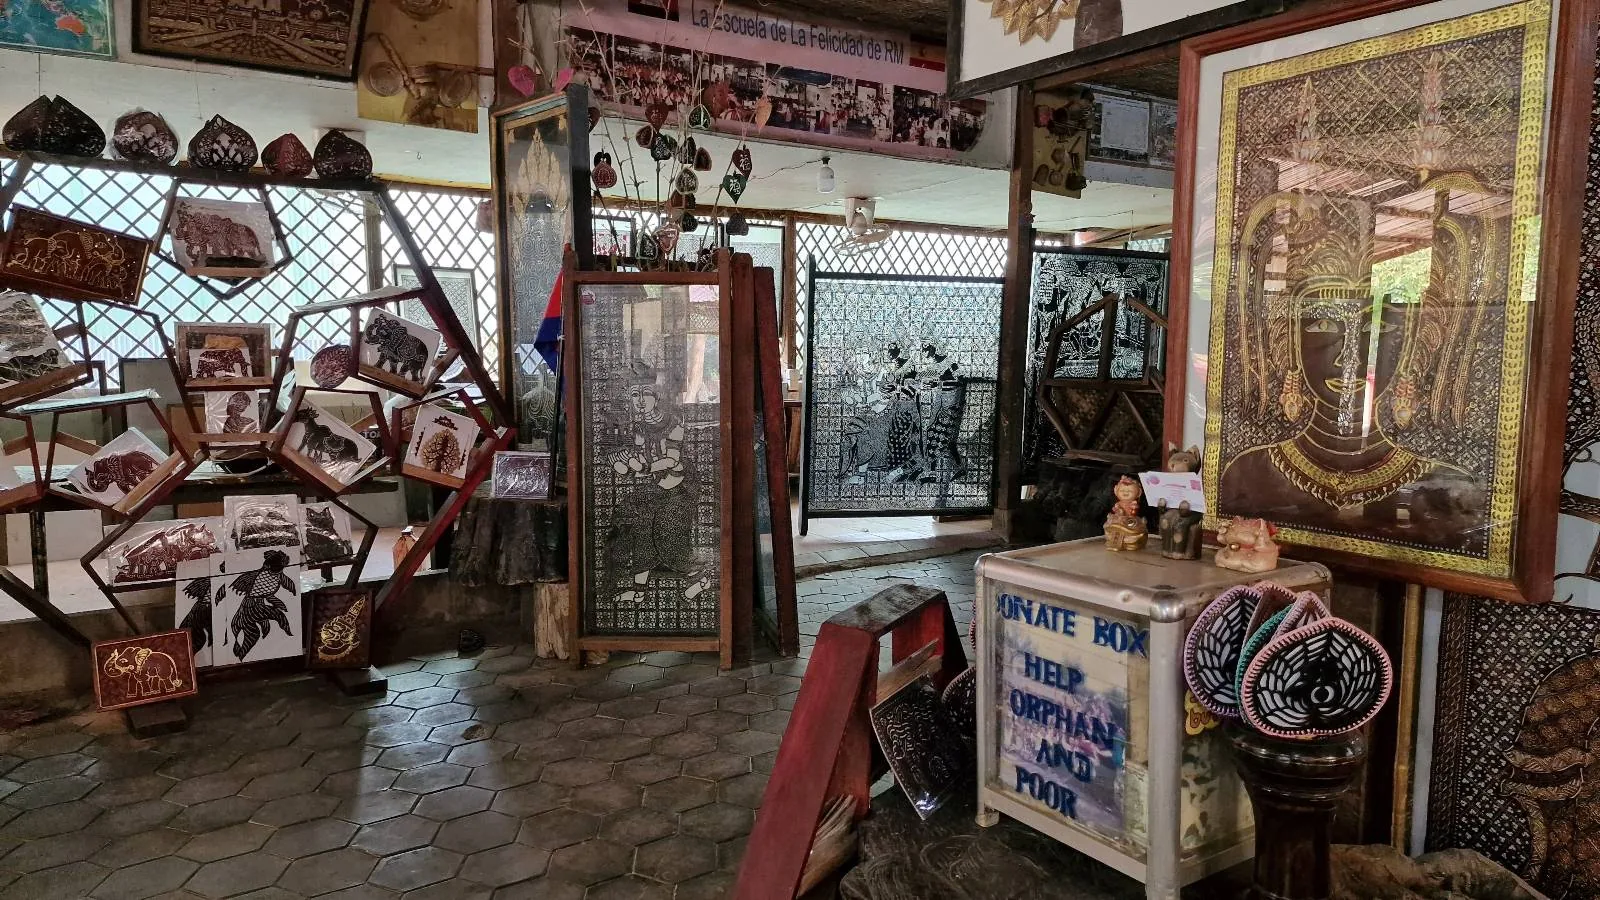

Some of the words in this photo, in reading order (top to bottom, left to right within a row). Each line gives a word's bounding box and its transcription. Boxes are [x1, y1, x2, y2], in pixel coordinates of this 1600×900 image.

[692, 0, 709, 28] La
[713, 5, 767, 39] Escuela
[771, 16, 787, 42] de
[791, 20, 806, 46] La
[810, 24, 864, 57] Felicidad
[867, 37, 882, 60] de
[884, 39, 904, 64] RM
[1093, 615, 1149, 658] BOX
[1024, 651, 1085, 694] HELP
[1010, 688, 1117, 749] ORPHAN
[1036, 738, 1092, 783] AND
[1015, 765, 1078, 820] POOR
